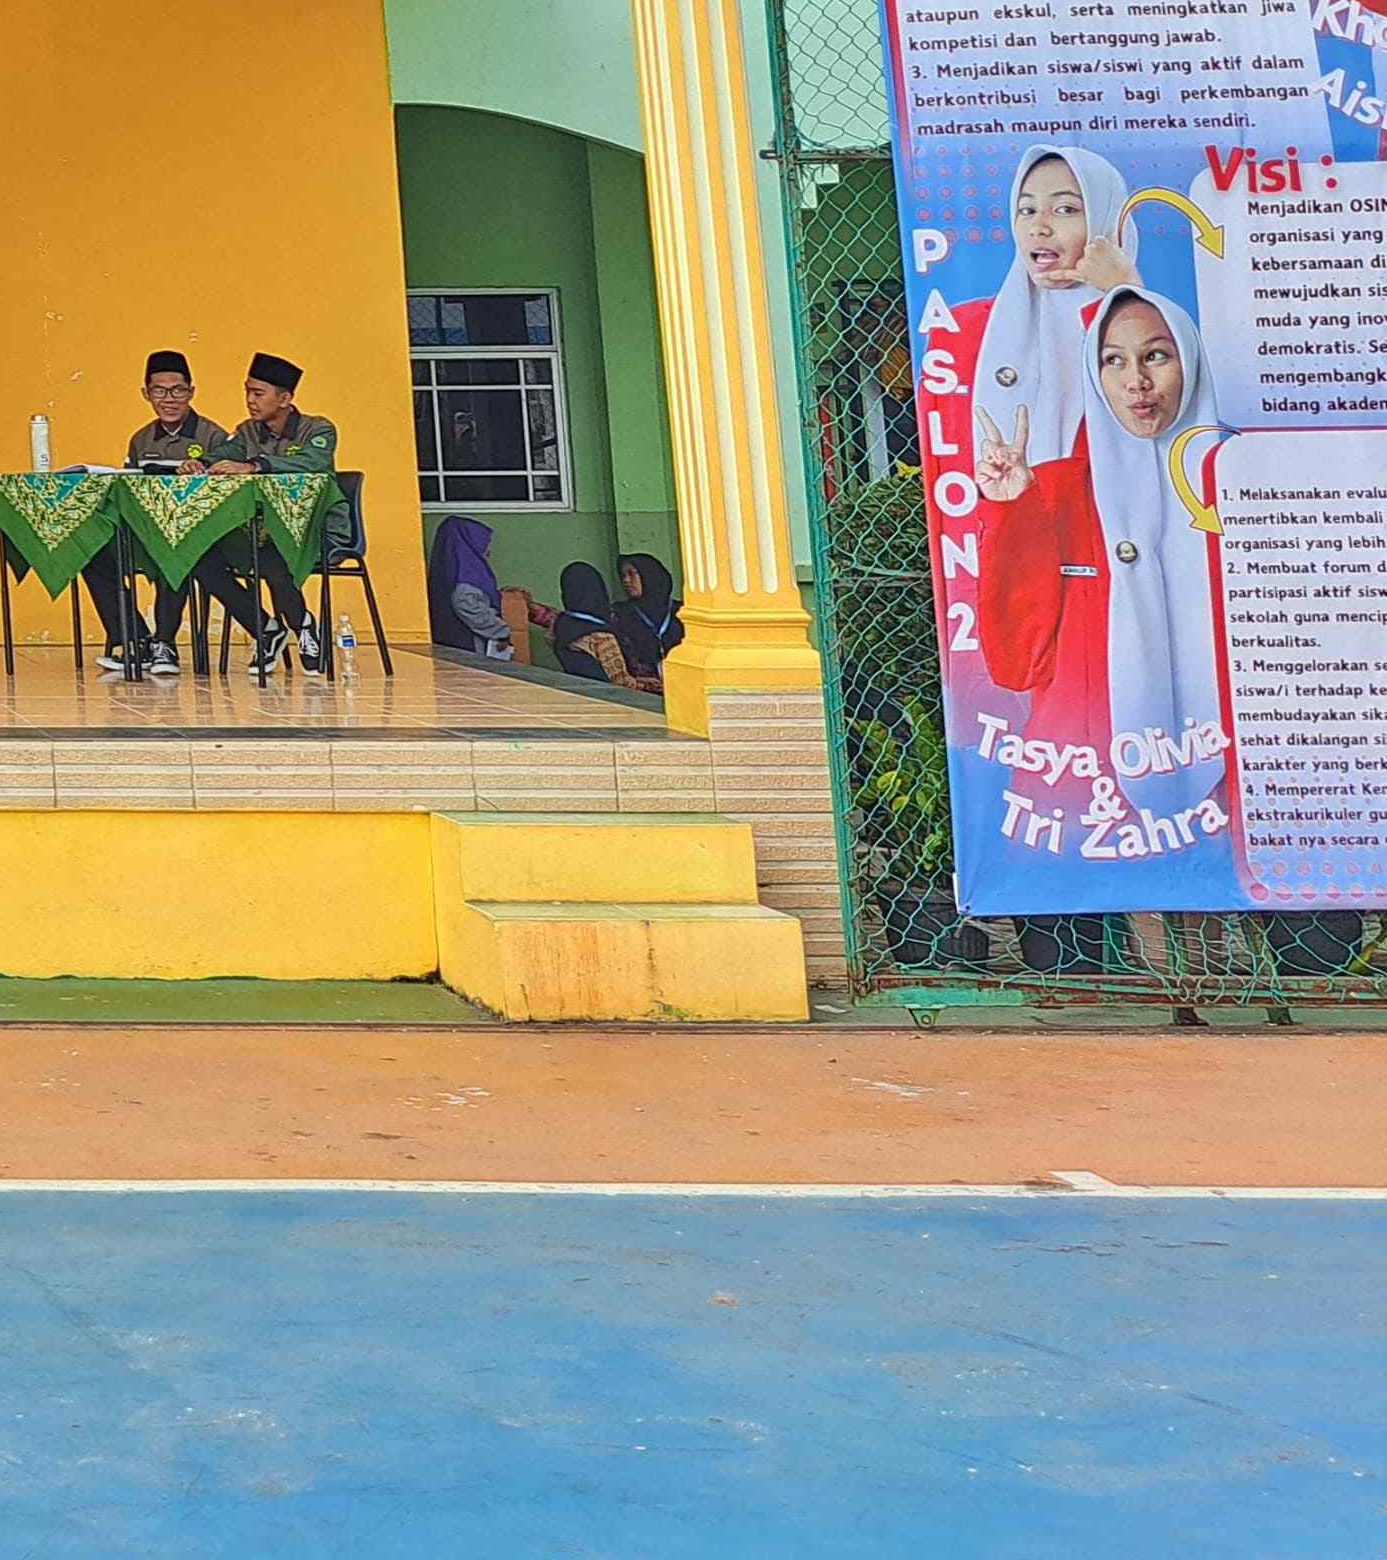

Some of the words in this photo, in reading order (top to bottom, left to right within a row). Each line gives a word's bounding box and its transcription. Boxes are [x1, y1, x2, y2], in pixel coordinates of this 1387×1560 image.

[918, 120, 1003, 136] madrasah
[1011, 119, 1082, 134] maupun
[1089, 116, 1117, 131] diri
[1125, 115, 1187, 129] mereka
[1193, 113, 1256, 128] sendiri.
[1205, 145, 1301, 193] Visi
[947, 603, 979, 652] 2
[1232, 635, 1321, 650] berkualitas.
[977, 712, 1101, 786] Tasya
[1110, 717, 1231, 777] Olivia
[1001, 789, 1065, 854] Tri
[1080, 798, 1228, 858] Zahra
[1089, 776, 1125, 823] &
